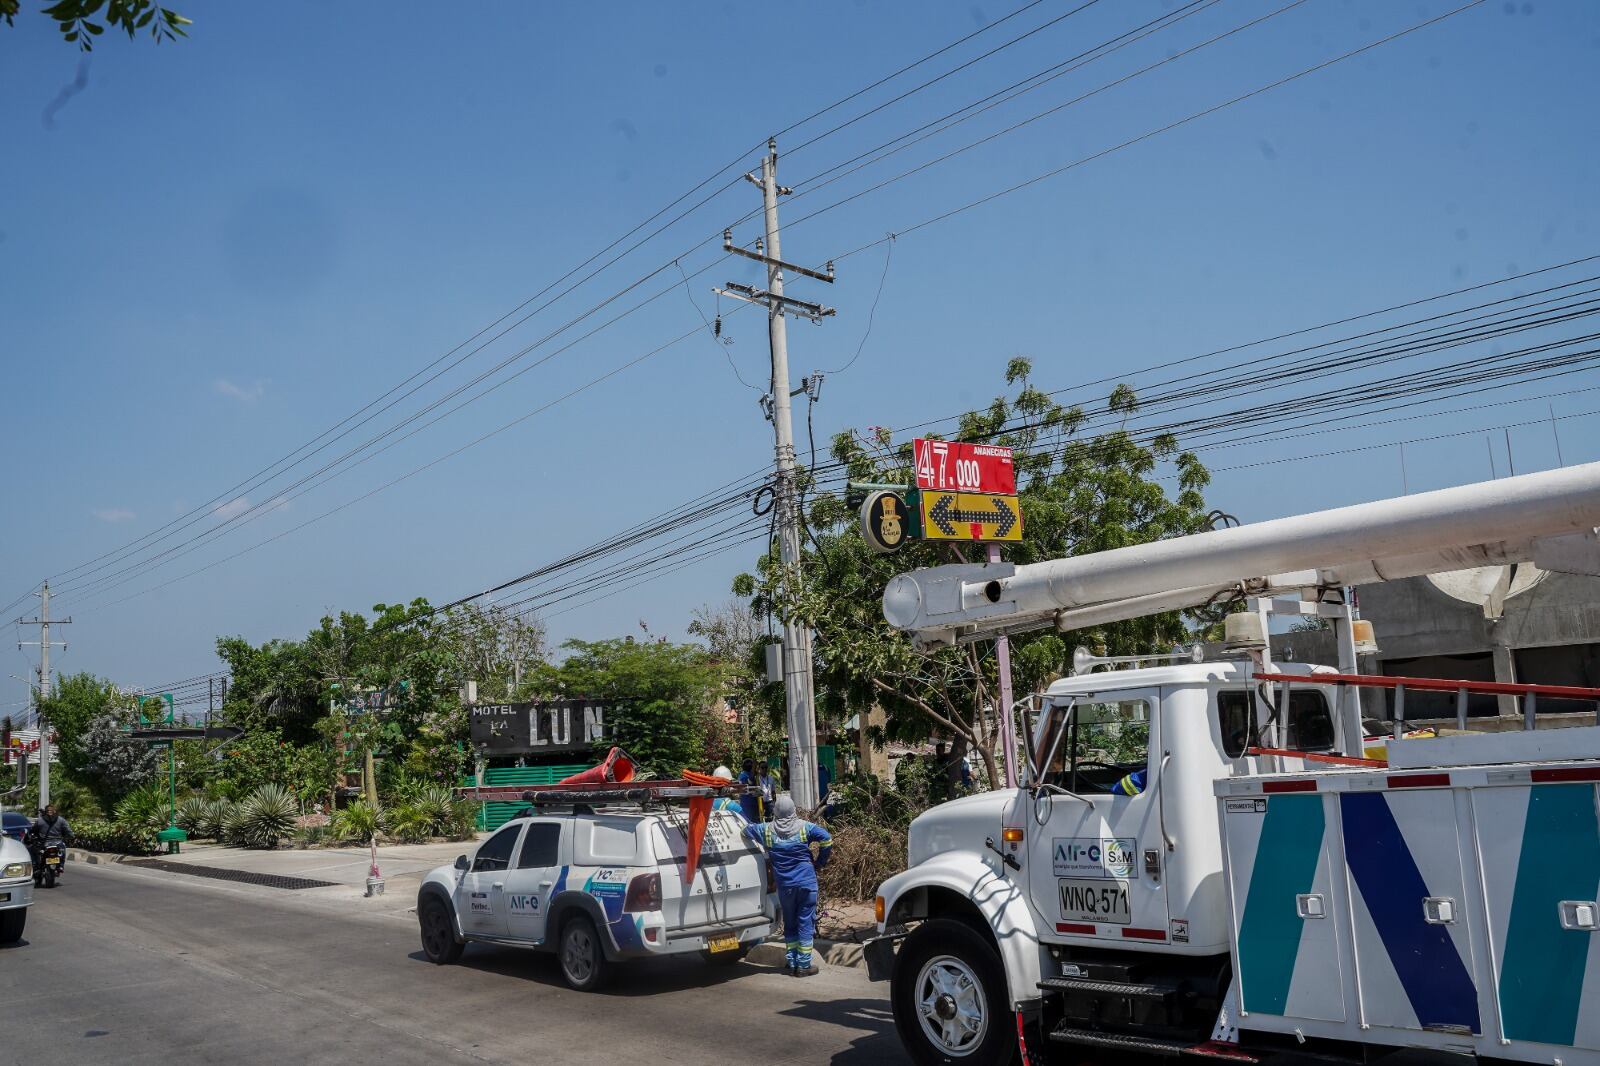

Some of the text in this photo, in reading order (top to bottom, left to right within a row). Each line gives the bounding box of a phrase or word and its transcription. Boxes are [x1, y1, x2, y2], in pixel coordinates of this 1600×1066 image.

[473, 705, 516, 716] MOTEL
[529, 706, 603, 746] LUN
[1108, 850, 1133, 863] S&M
